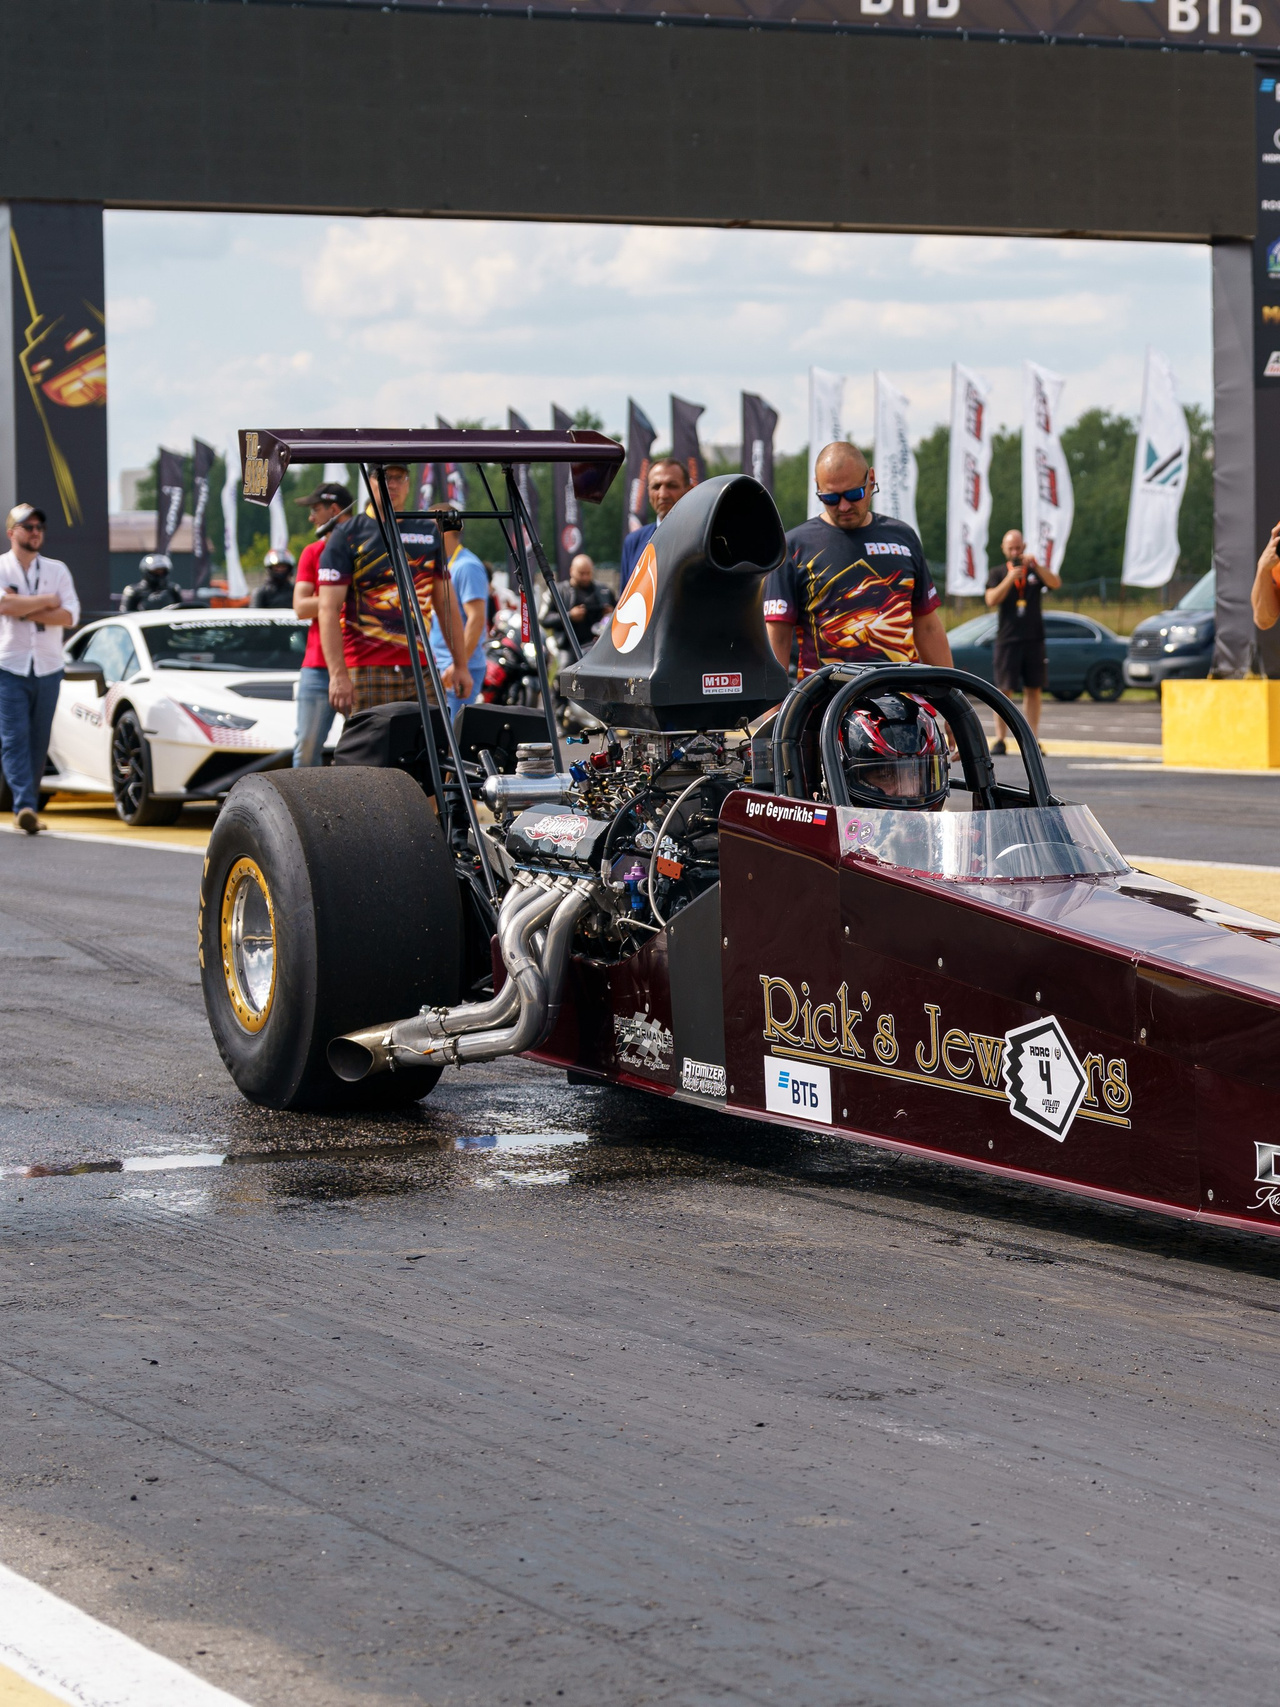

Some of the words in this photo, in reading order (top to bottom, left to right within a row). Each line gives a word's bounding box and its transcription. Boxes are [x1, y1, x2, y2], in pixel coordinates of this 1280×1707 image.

[704, 676, 730, 687] M1D
[746, 798, 766, 818] Igor
[766, 801, 814, 824] Geynrikhs
[759, 974, 898, 1065] Rick's
[915, 1002, 1132, 1114] Jewrs
[1029, 1045, 1051, 1058] RDRC
[1038, 1059, 1053, 1095] 4
[791, 1080, 818, 1108] ВТБ
[1044, 1106, 1059, 1114] FEST
